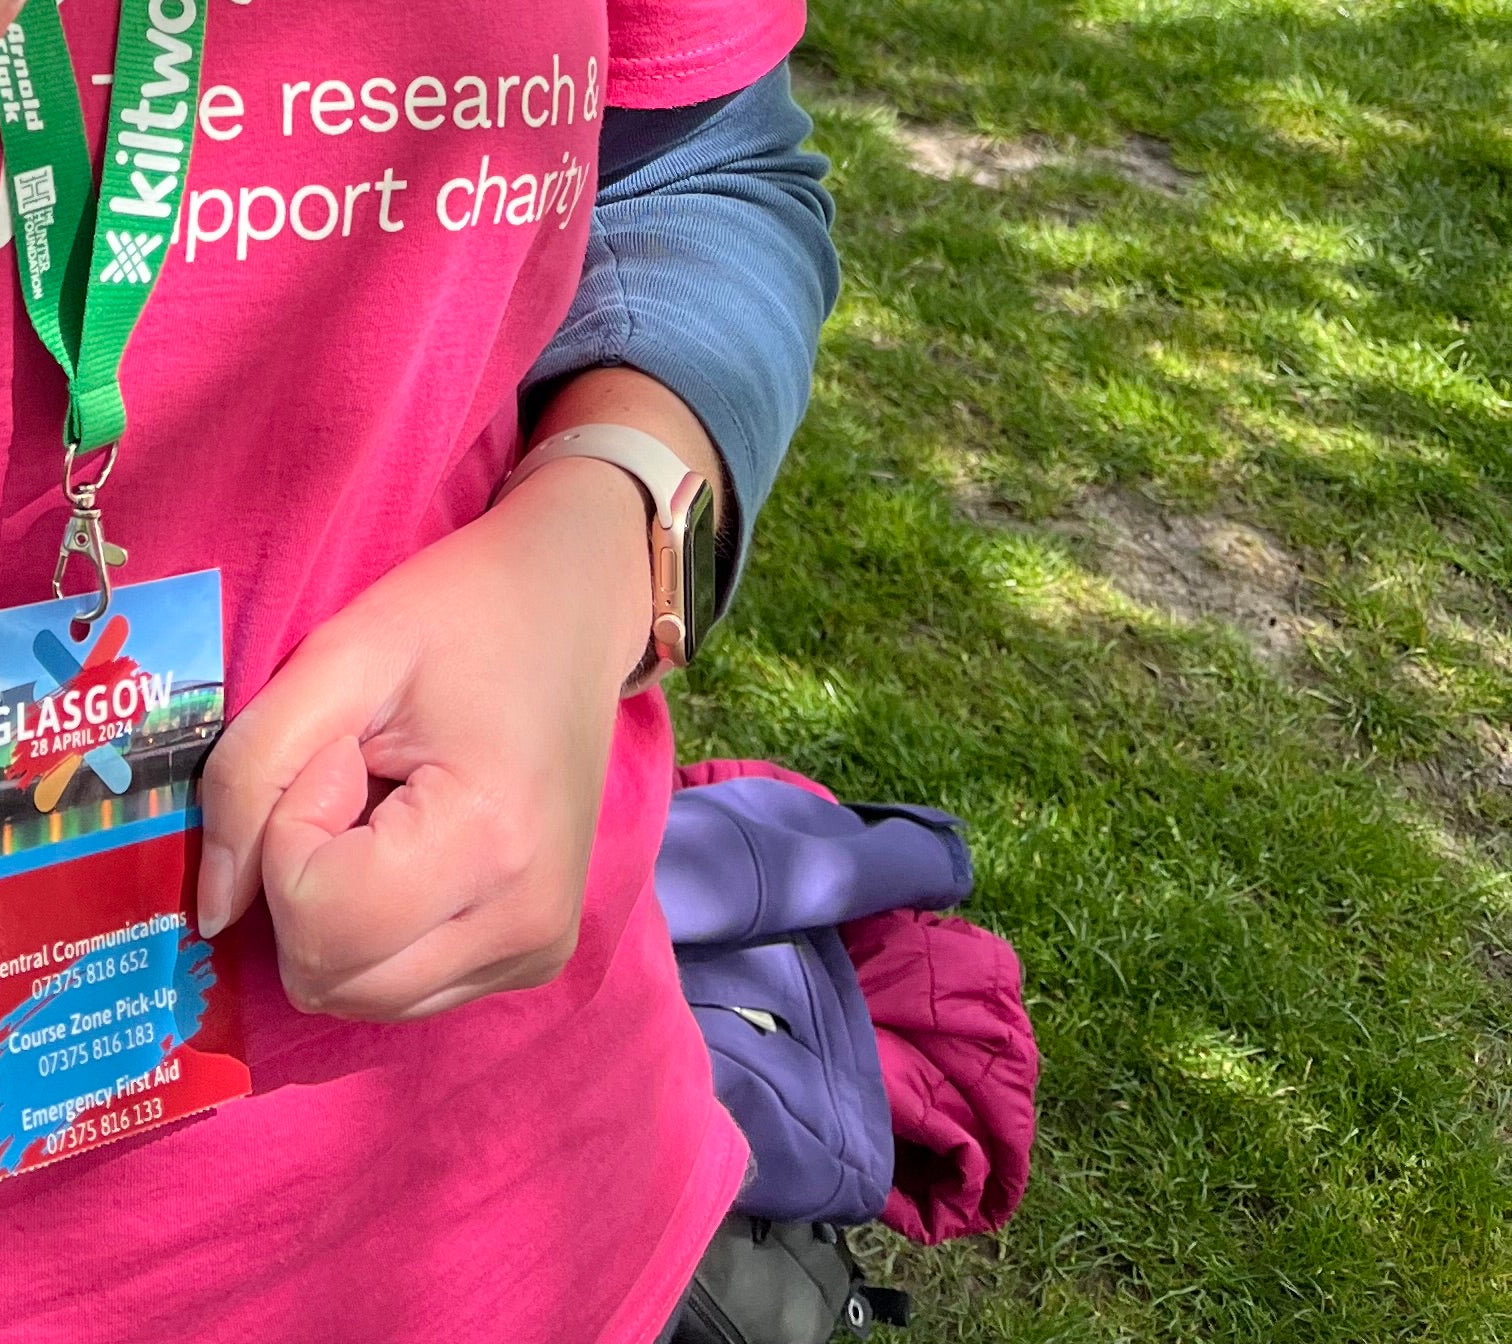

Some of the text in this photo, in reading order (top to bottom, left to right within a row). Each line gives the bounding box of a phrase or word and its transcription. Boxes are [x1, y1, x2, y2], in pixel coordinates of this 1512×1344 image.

[282, 54, 575, 137] research
[584, 55, 600, 122] &
[171, 150, 591, 264] pport charity
[23, 214, 44, 300] FOUNDATION
[33, 211, 51, 272] HUNTER
[29, 718, 133, 759] 28 APRIL 2024
[52, 910, 188, 963] Communications
[31, 947, 149, 1000] 07375 818 652
[8, 987, 178, 1055] Course Zone Pick-Up
[38, 1021, 155, 1078] 07375 816 183
[21, 1058, 181, 1132] Emergency First Aid
[46, 1096, 164, 1156] 07375 816 133
